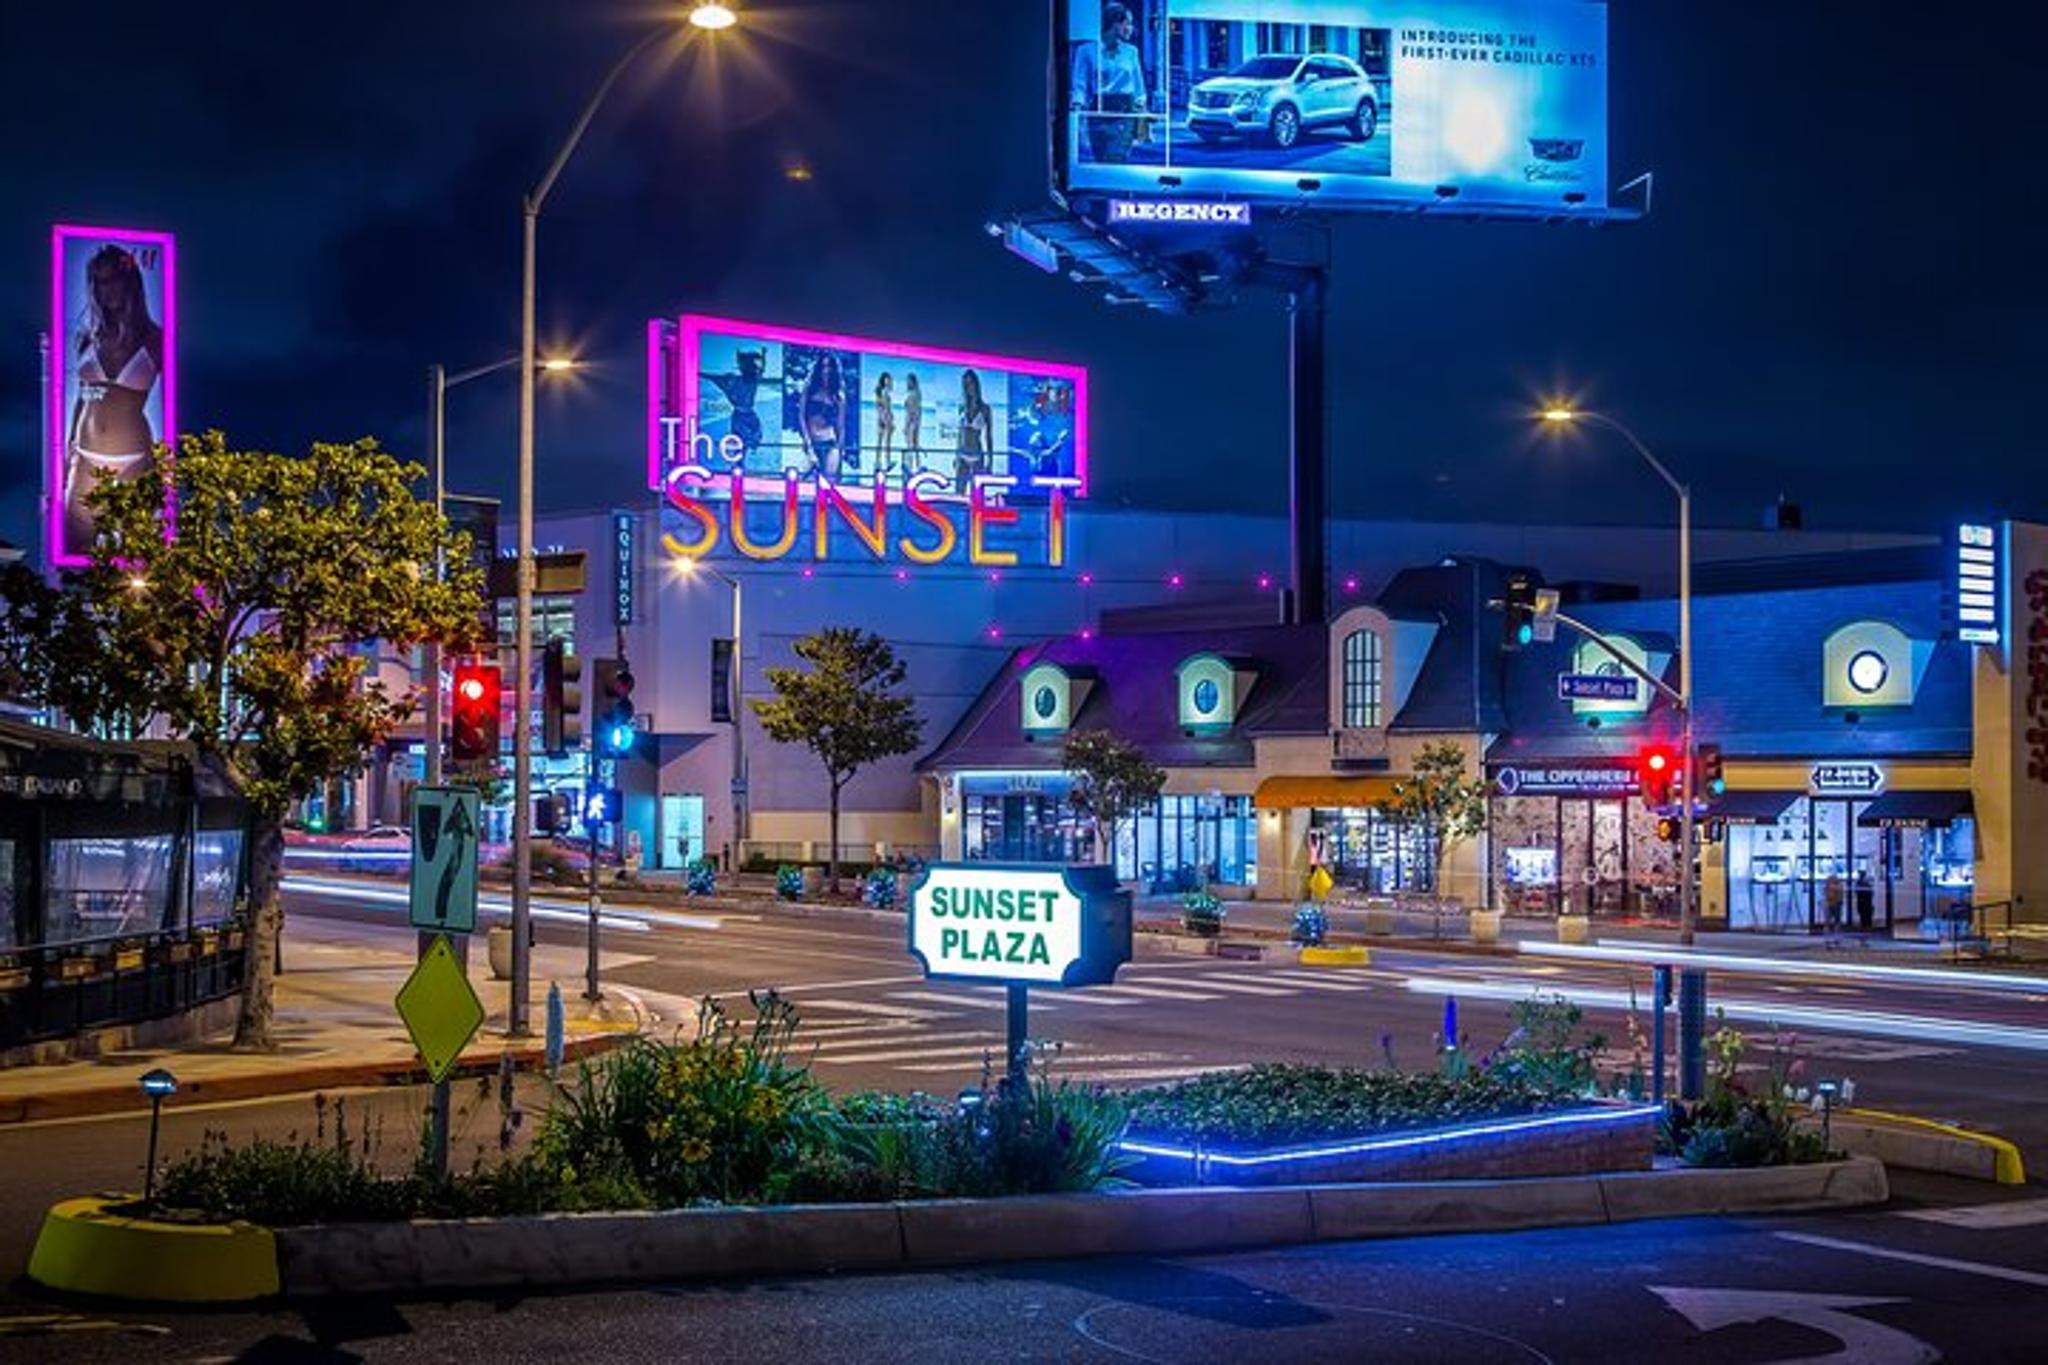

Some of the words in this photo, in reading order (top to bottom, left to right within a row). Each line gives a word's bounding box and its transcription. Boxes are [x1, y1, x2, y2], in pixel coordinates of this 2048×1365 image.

[1401, 29, 1504, 46] INTRODUCING
[1510, 34, 1536, 46] THE
[1493, 51, 1564, 65] CADILLAC
[1119, 203, 1244, 221] REGENCY
[659, 416, 744, 461] The
[662, 465, 1083, 567] SUNSET
[618, 516, 631, 621] EQUINOX
[1519, 770, 1547, 782] THE
[931, 887, 1060, 922] SUNSET
[941, 928, 1051, 965] PLAZA
